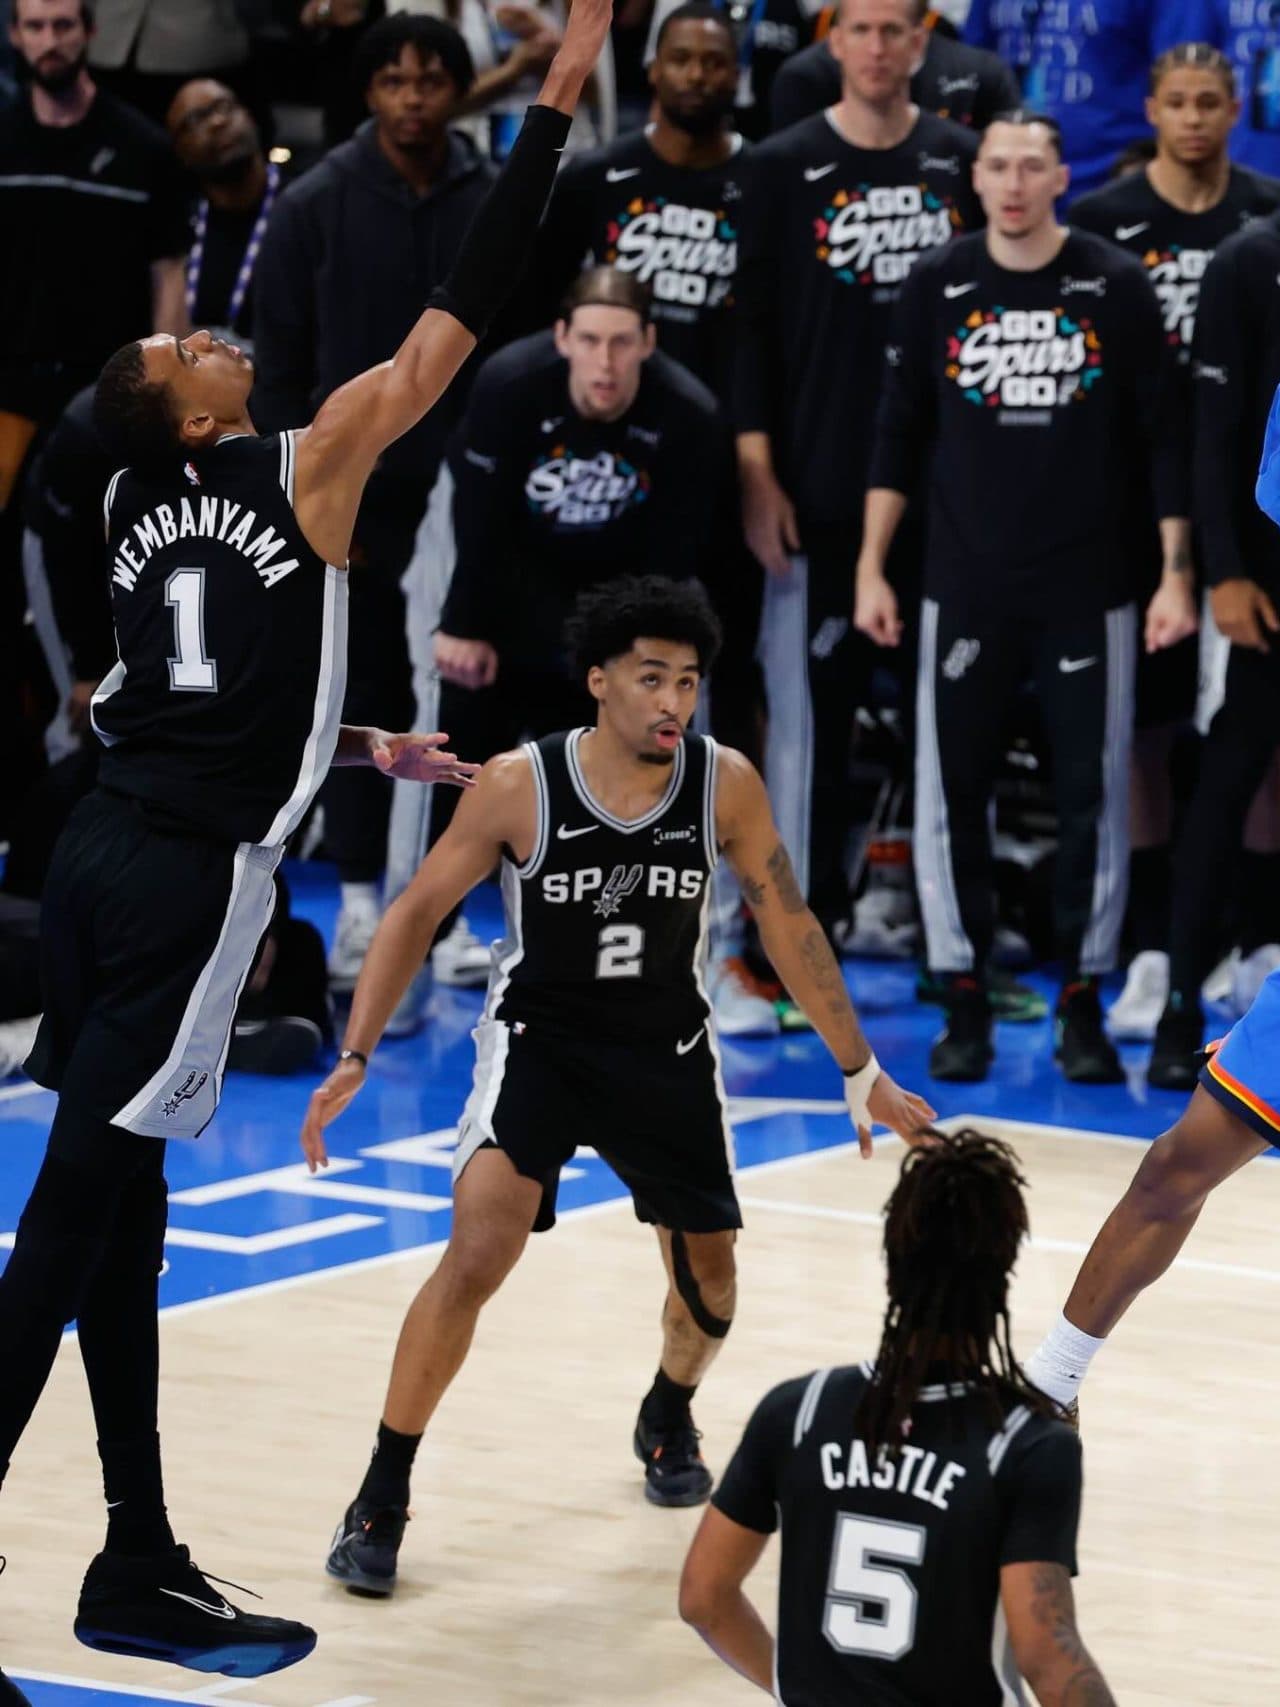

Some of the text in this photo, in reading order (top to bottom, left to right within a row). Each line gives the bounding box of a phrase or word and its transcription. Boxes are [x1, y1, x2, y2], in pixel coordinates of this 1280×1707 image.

[660, 203, 716, 241] GO
[866, 185, 922, 217] GO
[614, 211, 738, 283] Spurs
[827, 199, 952, 272] Spurs
[652, 269, 708, 306] GO
[1000, 310, 1057, 341] GO
[956, 320, 1087, 395] Spurs
[1001, 375, 1057, 407] GO
[112, 495, 300, 593] WEMBANYAMA
[164, 567, 218, 693] 1
[658, 829, 691, 841] LEDGER
[596, 924, 645, 979] 2
[820, 1439, 966, 1510] CASTLE
[821, 1510, 928, 1663] 5
